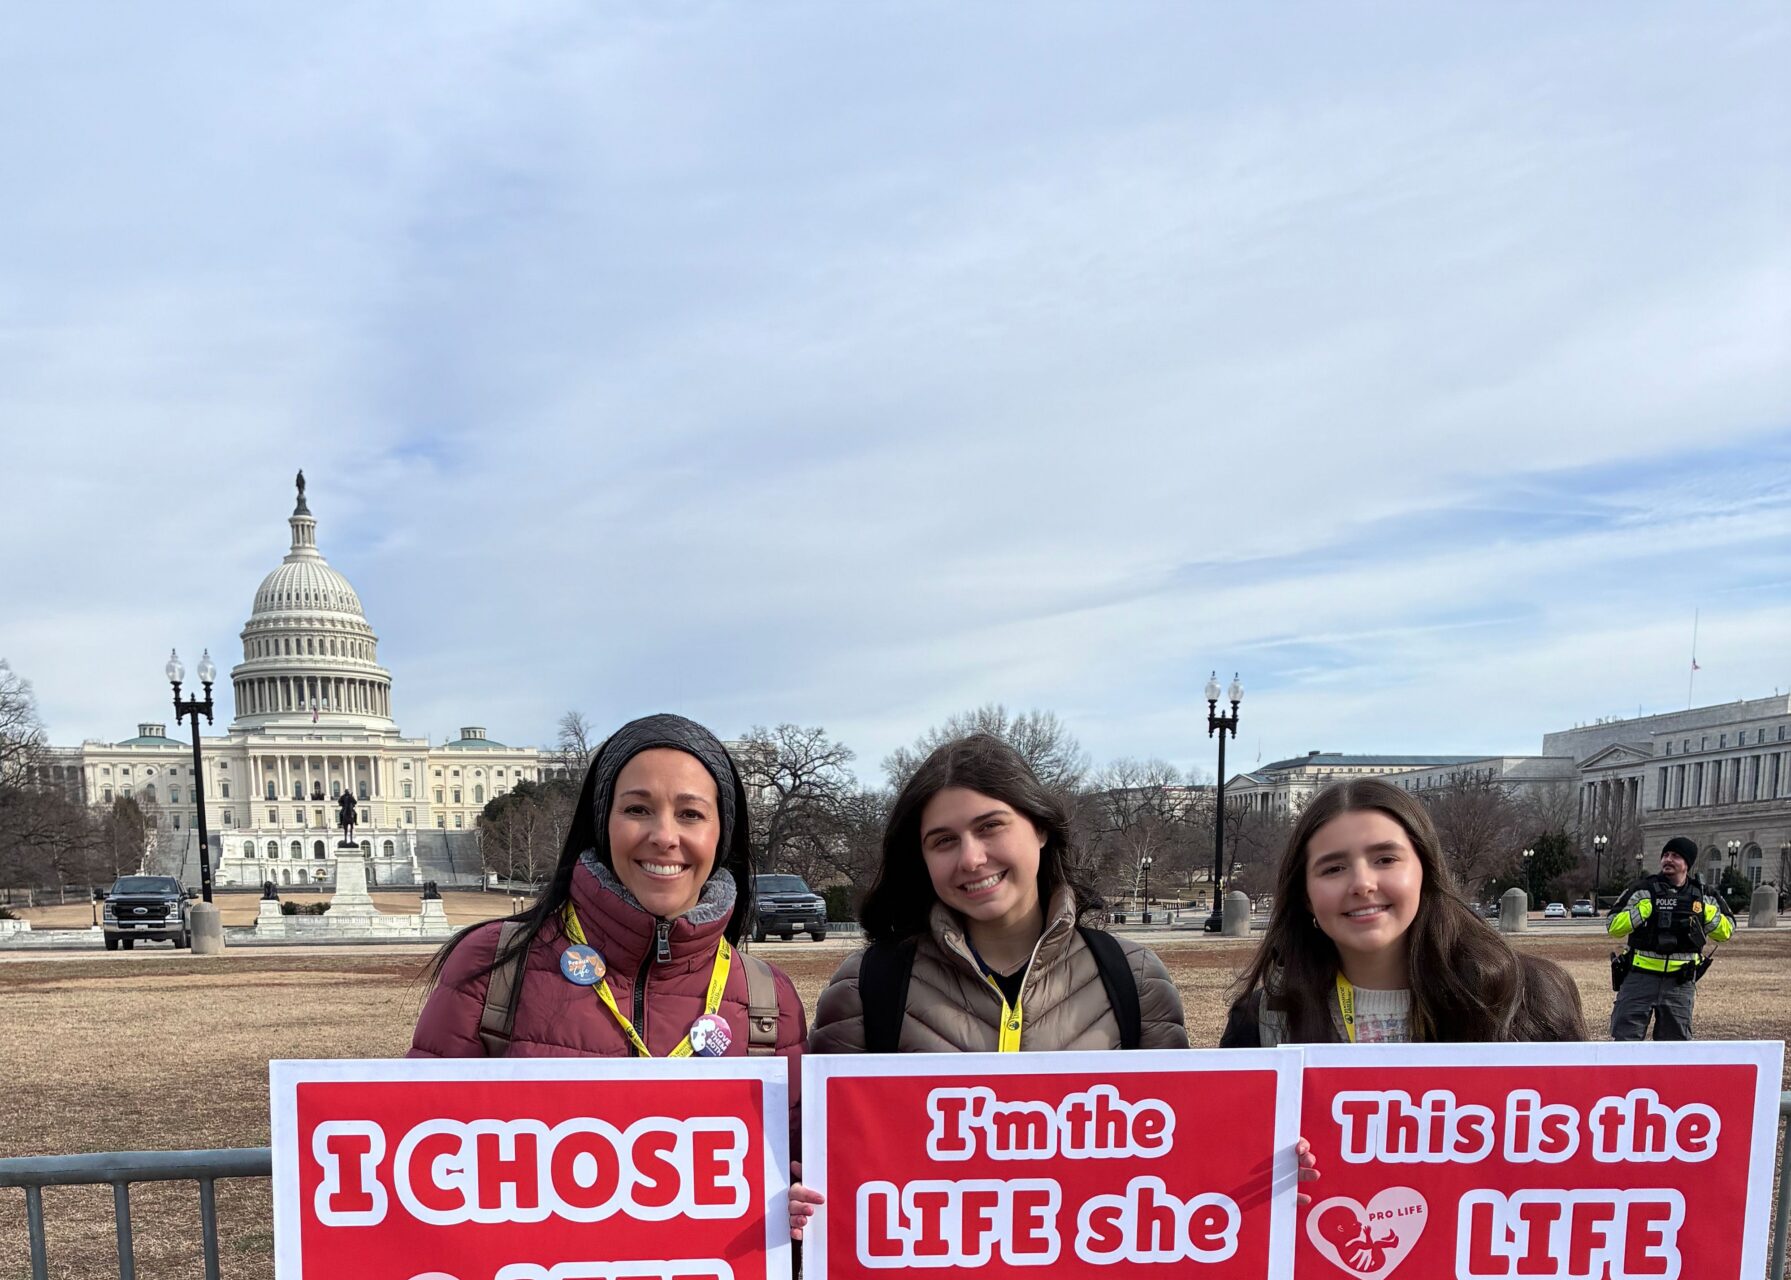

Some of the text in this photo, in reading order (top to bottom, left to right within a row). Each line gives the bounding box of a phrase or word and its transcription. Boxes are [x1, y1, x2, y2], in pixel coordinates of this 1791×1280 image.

[1655, 898, 1678, 906] POLICE
[706, 1038, 724, 1056] BOTH
[710, 1032, 728, 1052] THEM
[714, 1027, 732, 1047] LOVE
[931, 1089, 1171, 1156] I'm the
[1337, 1093, 1715, 1159] This is the
[320, 1123, 744, 1219] I CHOSE
[862, 1181, 1235, 1262] LIFE she
[1368, 1203, 1424, 1222] PRO LIFE
